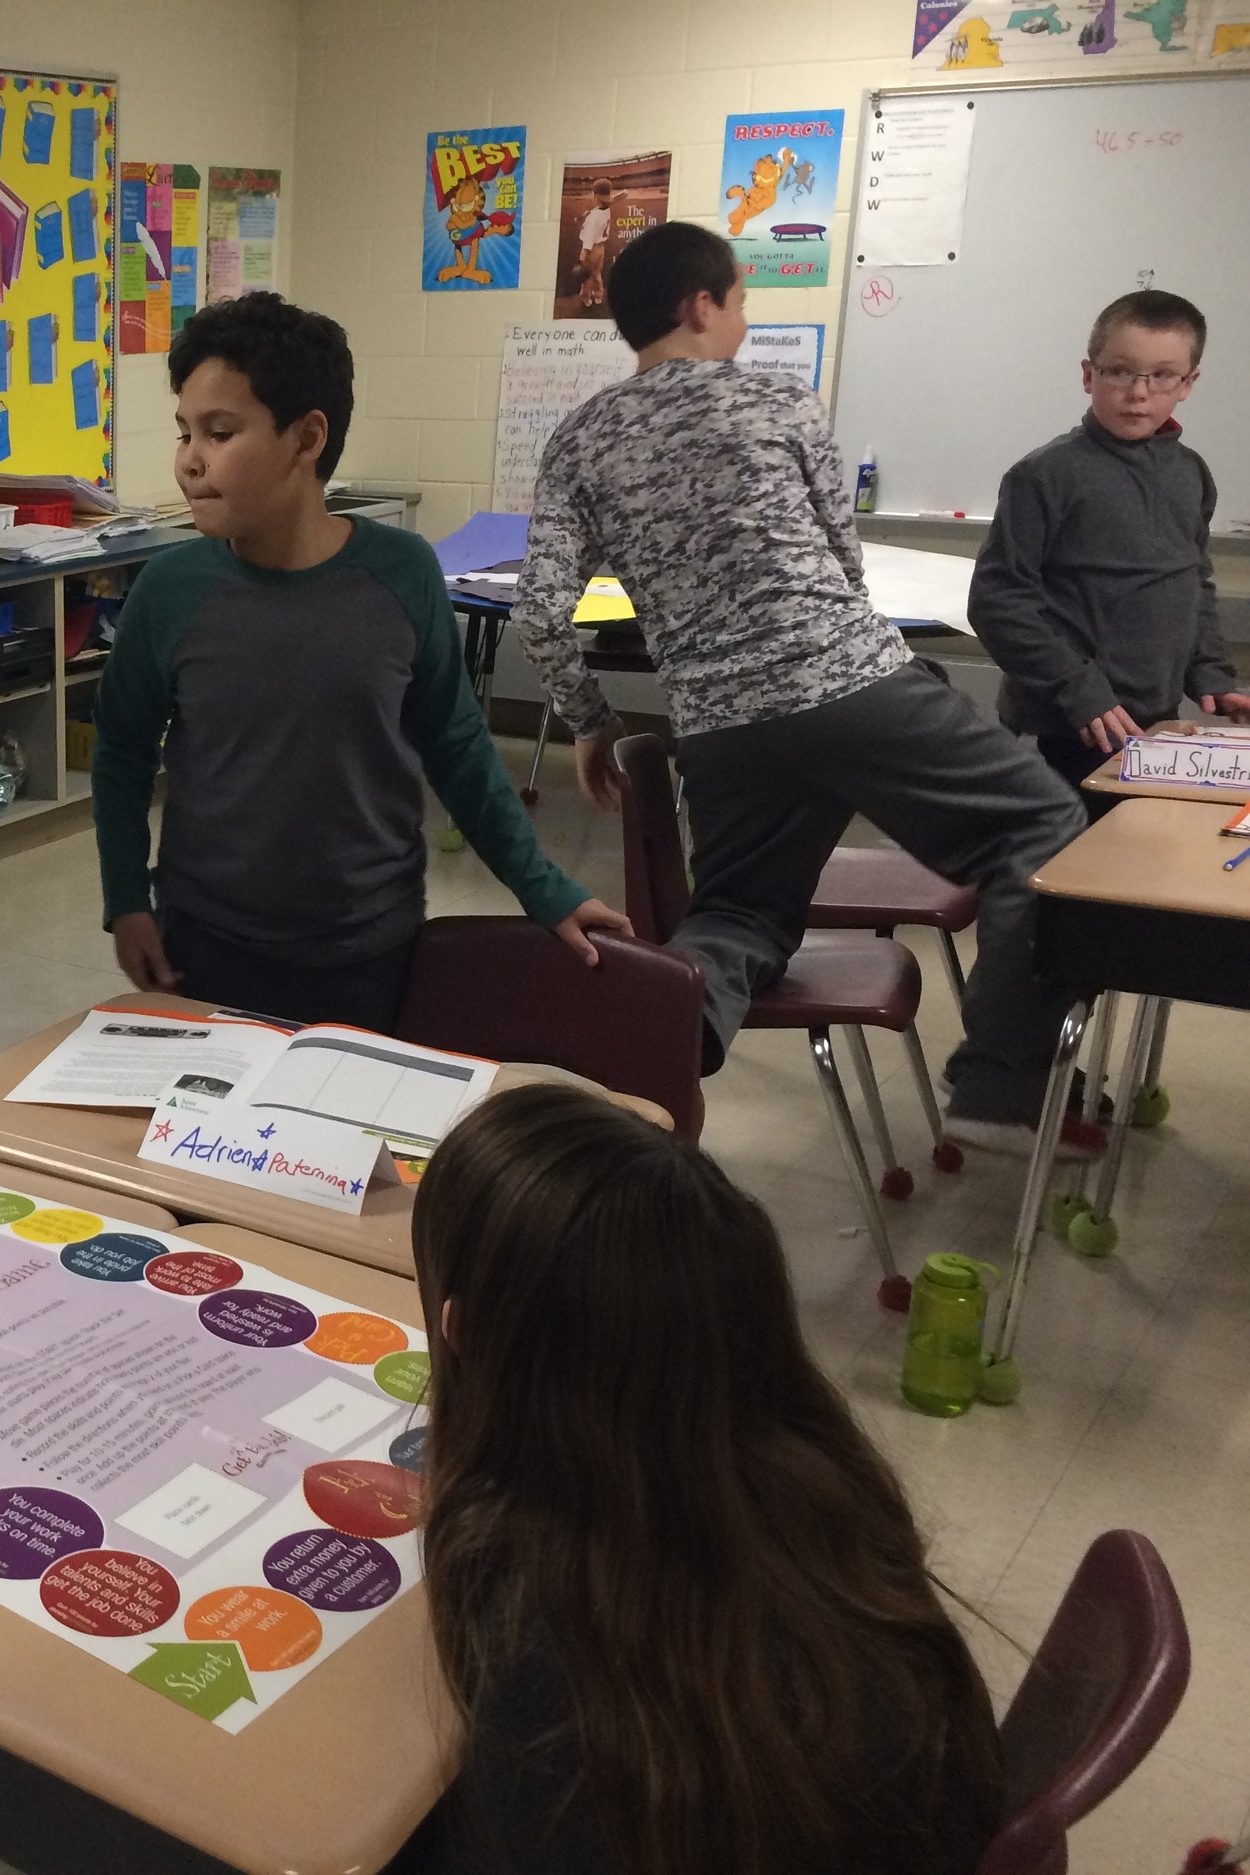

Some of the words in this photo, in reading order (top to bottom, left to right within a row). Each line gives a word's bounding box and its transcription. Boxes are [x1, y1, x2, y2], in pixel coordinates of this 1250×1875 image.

[734, 121, 835, 140] RESPECT.
[877, 123, 885, 134] R
[435, 141, 521, 194] BEST
[871, 151, 884, 162] W
[870, 177, 879, 187] D
[628, 205, 645, 216] The
[867, 200, 880, 210] W
[616, 216, 645, 229] expert
[648, 216, 657, 226] in
[780, 263, 816, 275] GET
[512, 327, 575, 342] Everyone
[584, 330, 606, 341] can
[517, 343, 536, 356] well
[543, 348, 552, 356] in
[558, 343, 584, 356] math
[752, 359, 779, 370] Proof
[1128, 750, 1178, 777] David
[222, 1299, 240, 1313] for
[239, 1306, 270, 1324] ready
[203, 1311, 246, 1335] uniform
[218, 1309, 261, 1332] washed
[261, 1327, 274, 1337] is
[268, 1319, 294, 1334] and
[243, 1331, 269, 1347] Your
[0, 1508, 32, 1525] your
[30, 1521, 62, 1543] work
[8, 1492, 32, 1509] You
[30, 1506, 86, 1537] complete
[9, 1529, 28, 1542] on
[27, 1537, 56, 1558] time.
[268, 1558, 295, 1572] You
[293, 1533, 324, 1558] return
[135, 1558, 158, 1575] You
[286, 1564, 315, 1585] extra
[310, 1538, 348, 1570] money
[298, 1575, 327, 1601] given
[325, 1567, 340, 1581] to
[335, 1552, 357, 1573] you
[353, 1541, 372, 1559] by
[78, 1562, 134, 1593] yourself.
[133, 1587, 163, 1608] Your
[104, 1558, 148, 1585] believe
[148, 1580, 163, 1592] in
[324, 1592, 339, 1603] a
[333, 1559, 382, 1596] customer.
[44, 1575, 70, 1590] get
[68, 1584, 90, 1601] the
[85, 1596, 110, 1613] job
[110, 1609, 143, 1633] done.
[60, 1564, 102, 1592] talents
[100, 1588, 129, 1606] and
[125, 1602, 159, 1624] skills
[198, 1611, 226, 1626] You
[222, 1590, 250, 1612] wear
[216, 1628, 229, 1638] a
[225, 1608, 257, 1632] smile
[252, 1597, 270, 1611] at
[255, 1609, 288, 1632] work.
[164, 1651, 233, 1700] Start
